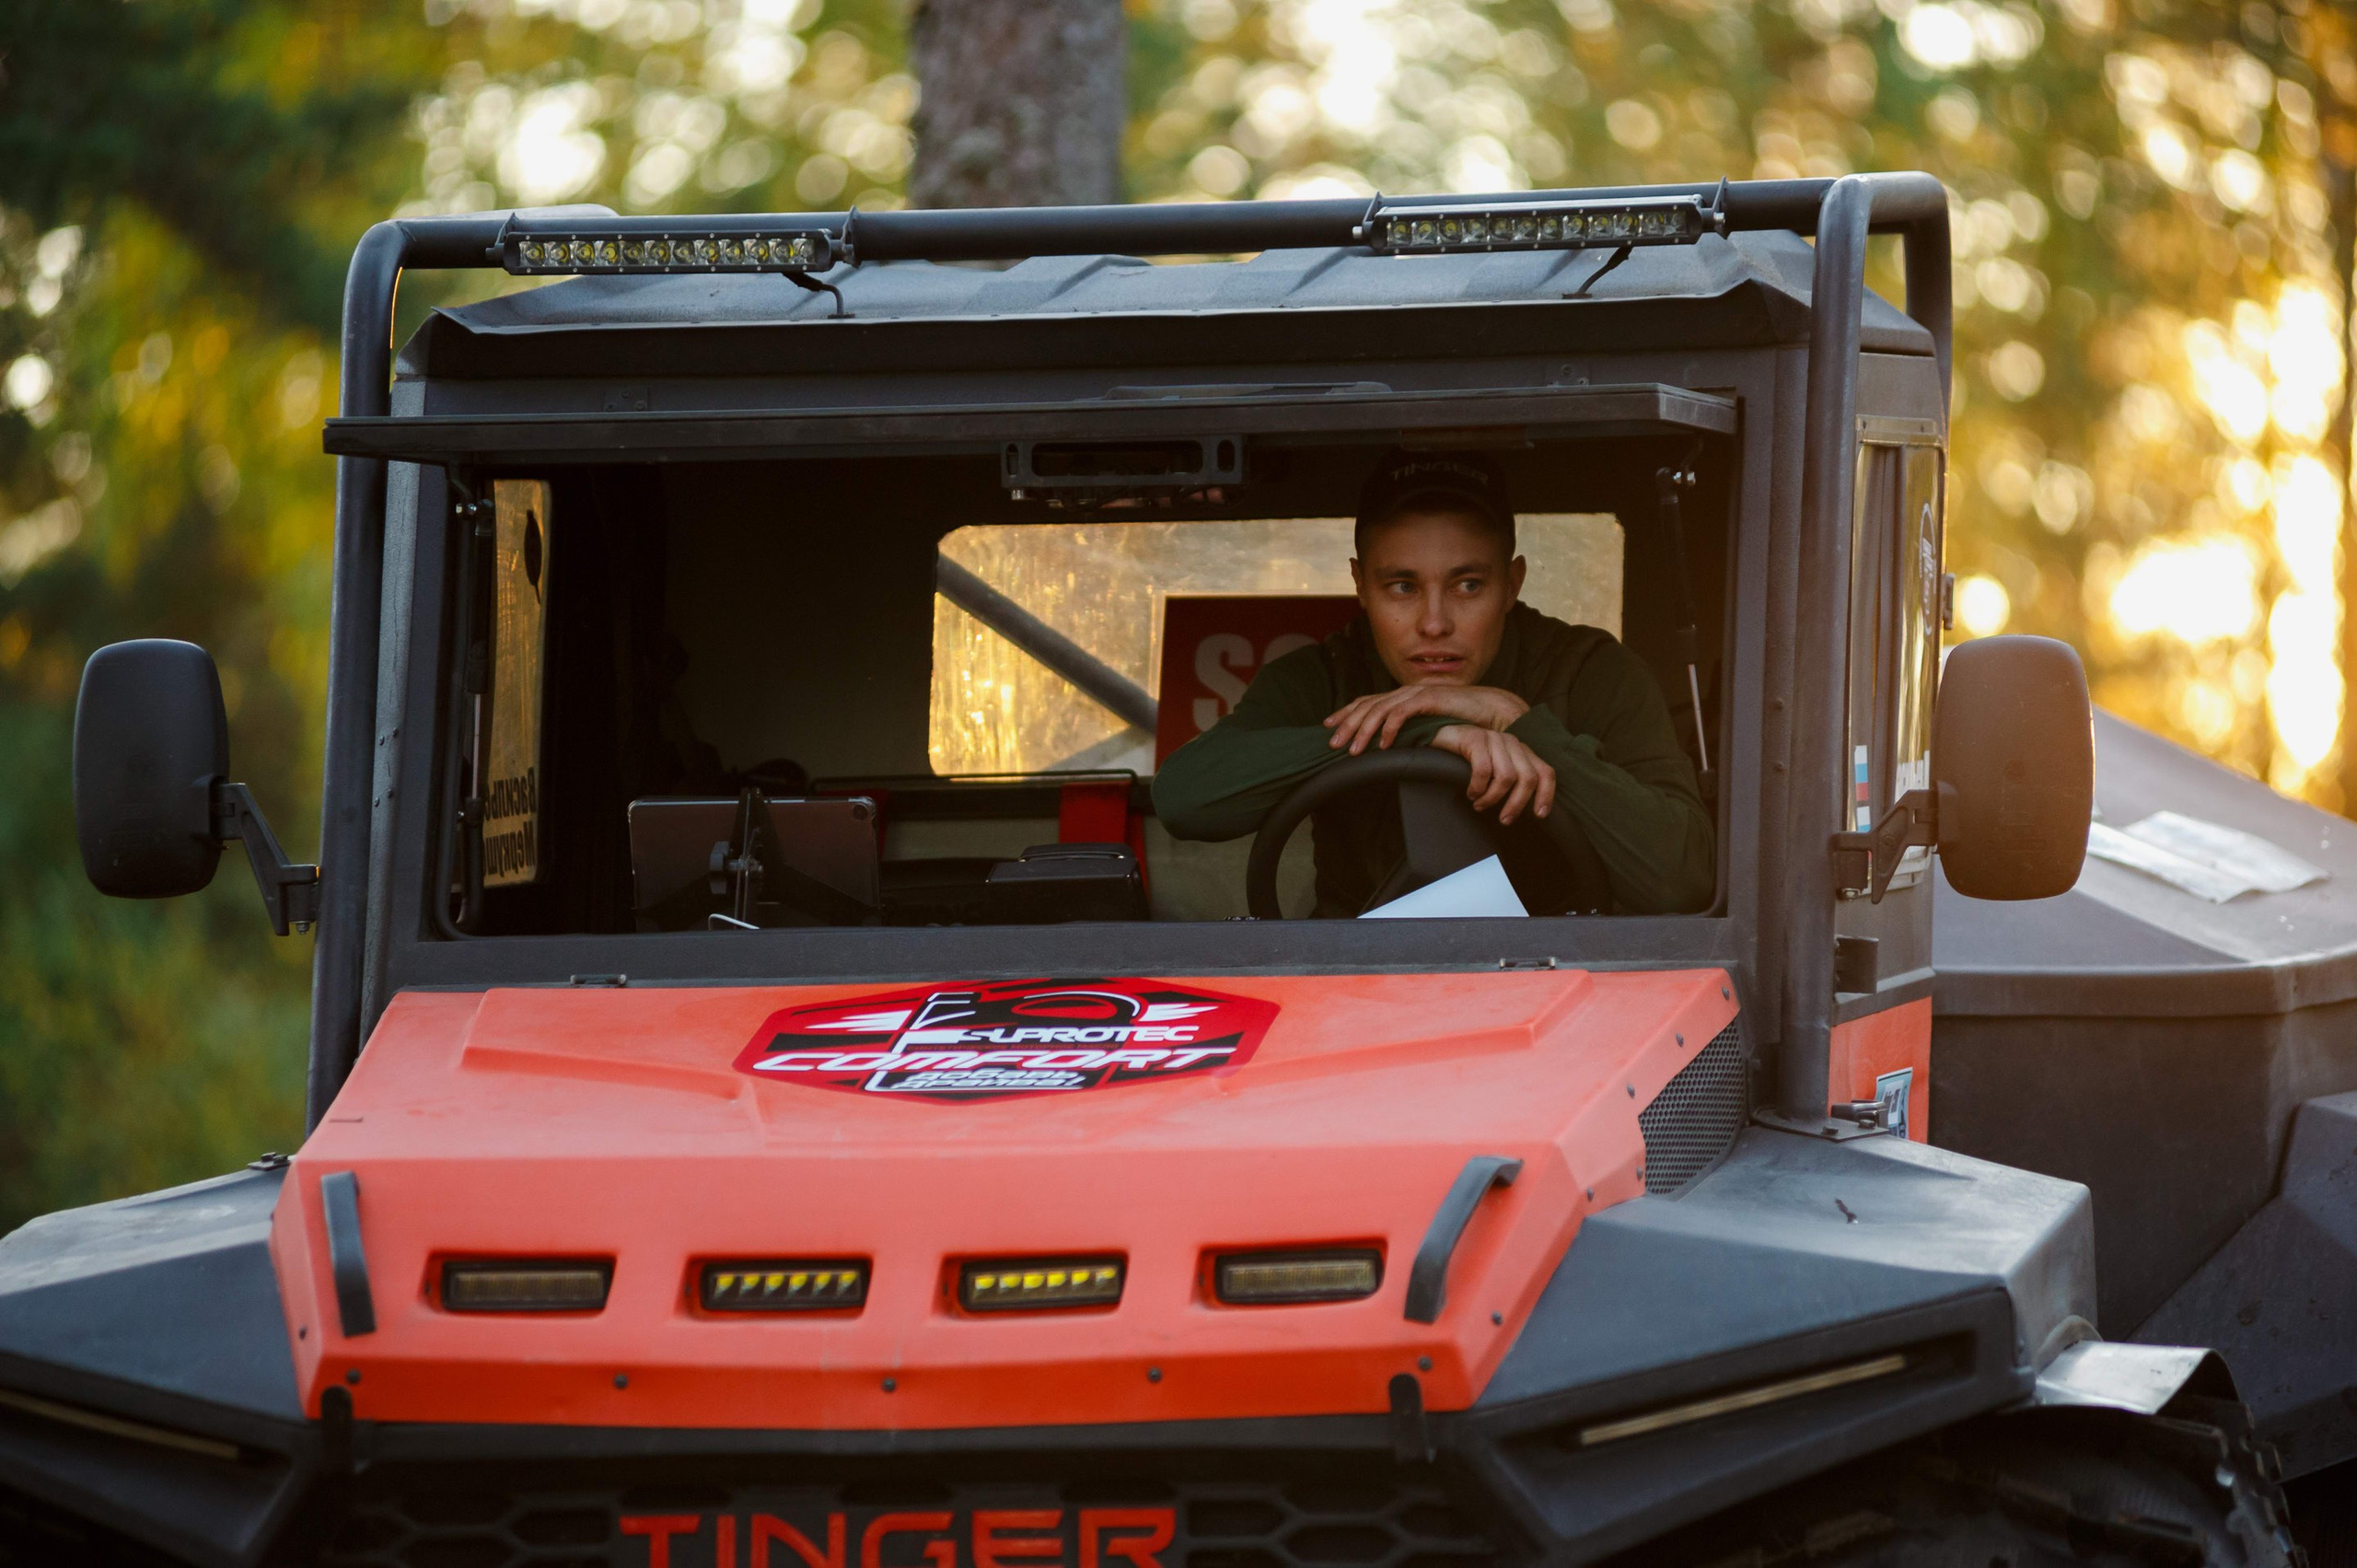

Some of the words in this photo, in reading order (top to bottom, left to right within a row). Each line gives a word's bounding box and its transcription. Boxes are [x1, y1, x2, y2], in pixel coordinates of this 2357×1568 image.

[963, 1025, 1201, 1044] SUPROTEC
[751, 1046, 1238, 1072] COMFORT
[619, 1507, 1177, 1568] TINGER
